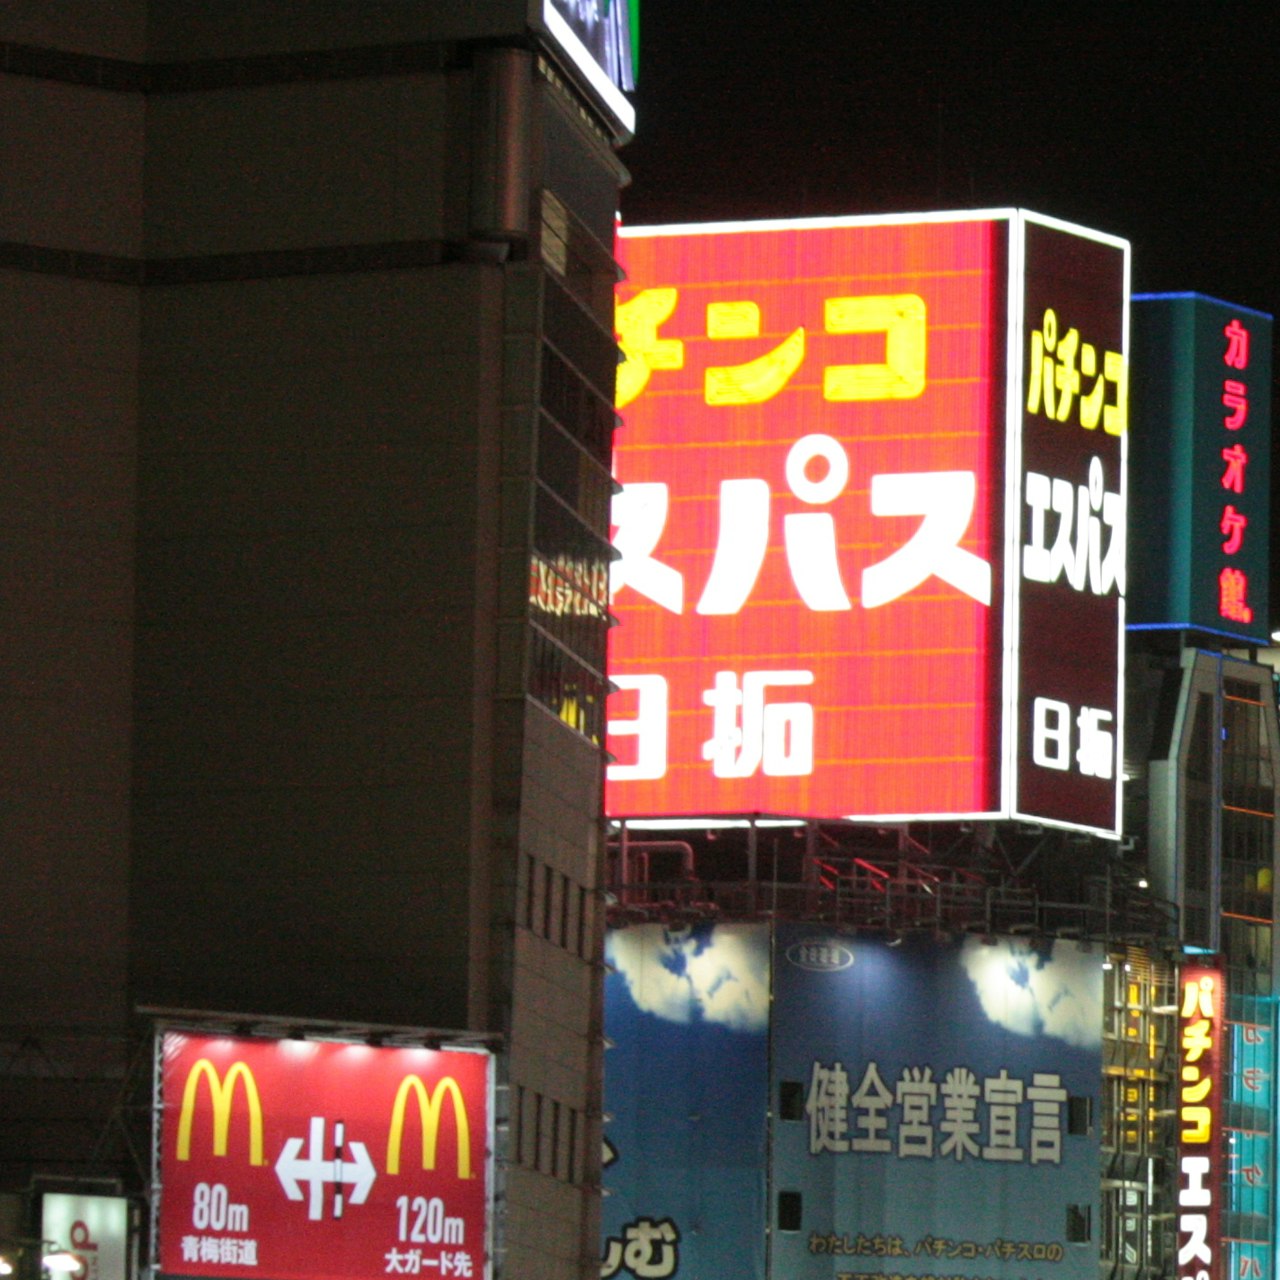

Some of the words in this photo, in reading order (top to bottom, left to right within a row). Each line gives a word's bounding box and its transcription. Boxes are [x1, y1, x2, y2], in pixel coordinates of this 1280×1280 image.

[1026, 308, 1124, 437] パチンコ
[1022, 455, 1125, 598] エスパス
[1033, 696, 1114, 781] 日拓
[1179, 975, 1215, 1144] パチンコ
[805, 1060, 1068, 1166] 健全営業宣言
[192, 1181, 249, 1232] 80m
[396, 1195, 465, 1245] 120m
[180, 1234, 258, 1266] 青梅街道
[384, 1248, 473, 1278] 大ガード先
